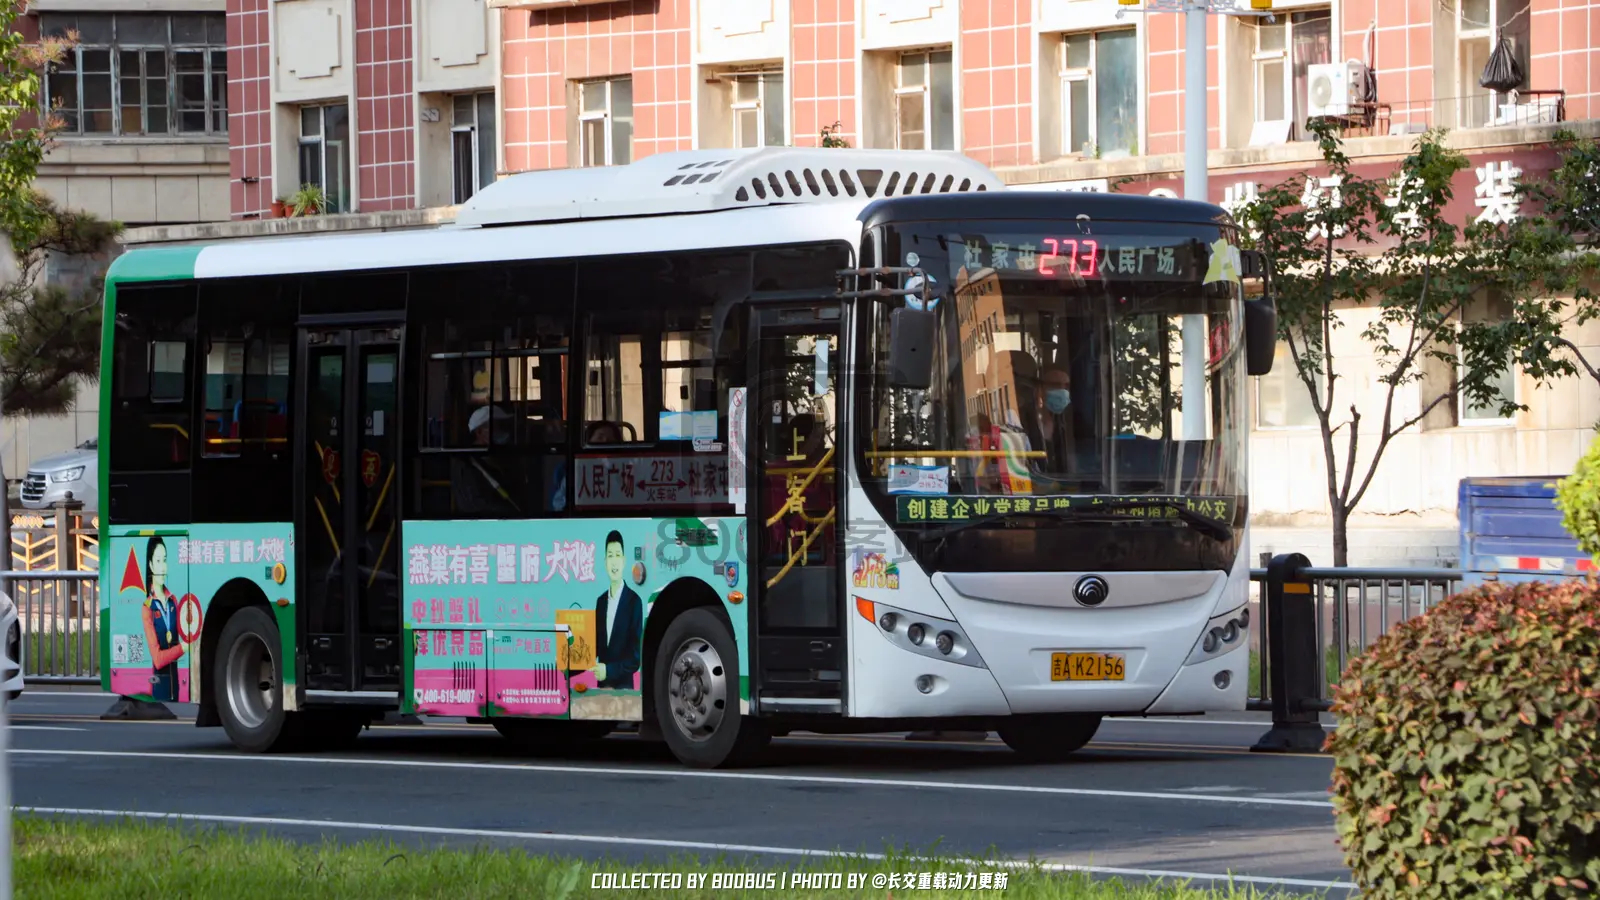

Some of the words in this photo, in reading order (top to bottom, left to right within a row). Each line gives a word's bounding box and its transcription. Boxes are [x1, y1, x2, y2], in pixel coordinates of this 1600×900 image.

[964, 240, 1036, 270] 杜家屯
[1038, 238, 1097, 276] 273
[1098, 246, 1175, 273] 人民广场
[578, 463, 635, 499] 人民广场
[651, 460, 674, 482] 273
[688, 460, 729, 498] 杜家屯
[646, 489, 677, 501] 火车站
[786, 427, 808, 567] 上客门
[409, 543, 490, 585] 燕巢有喜
